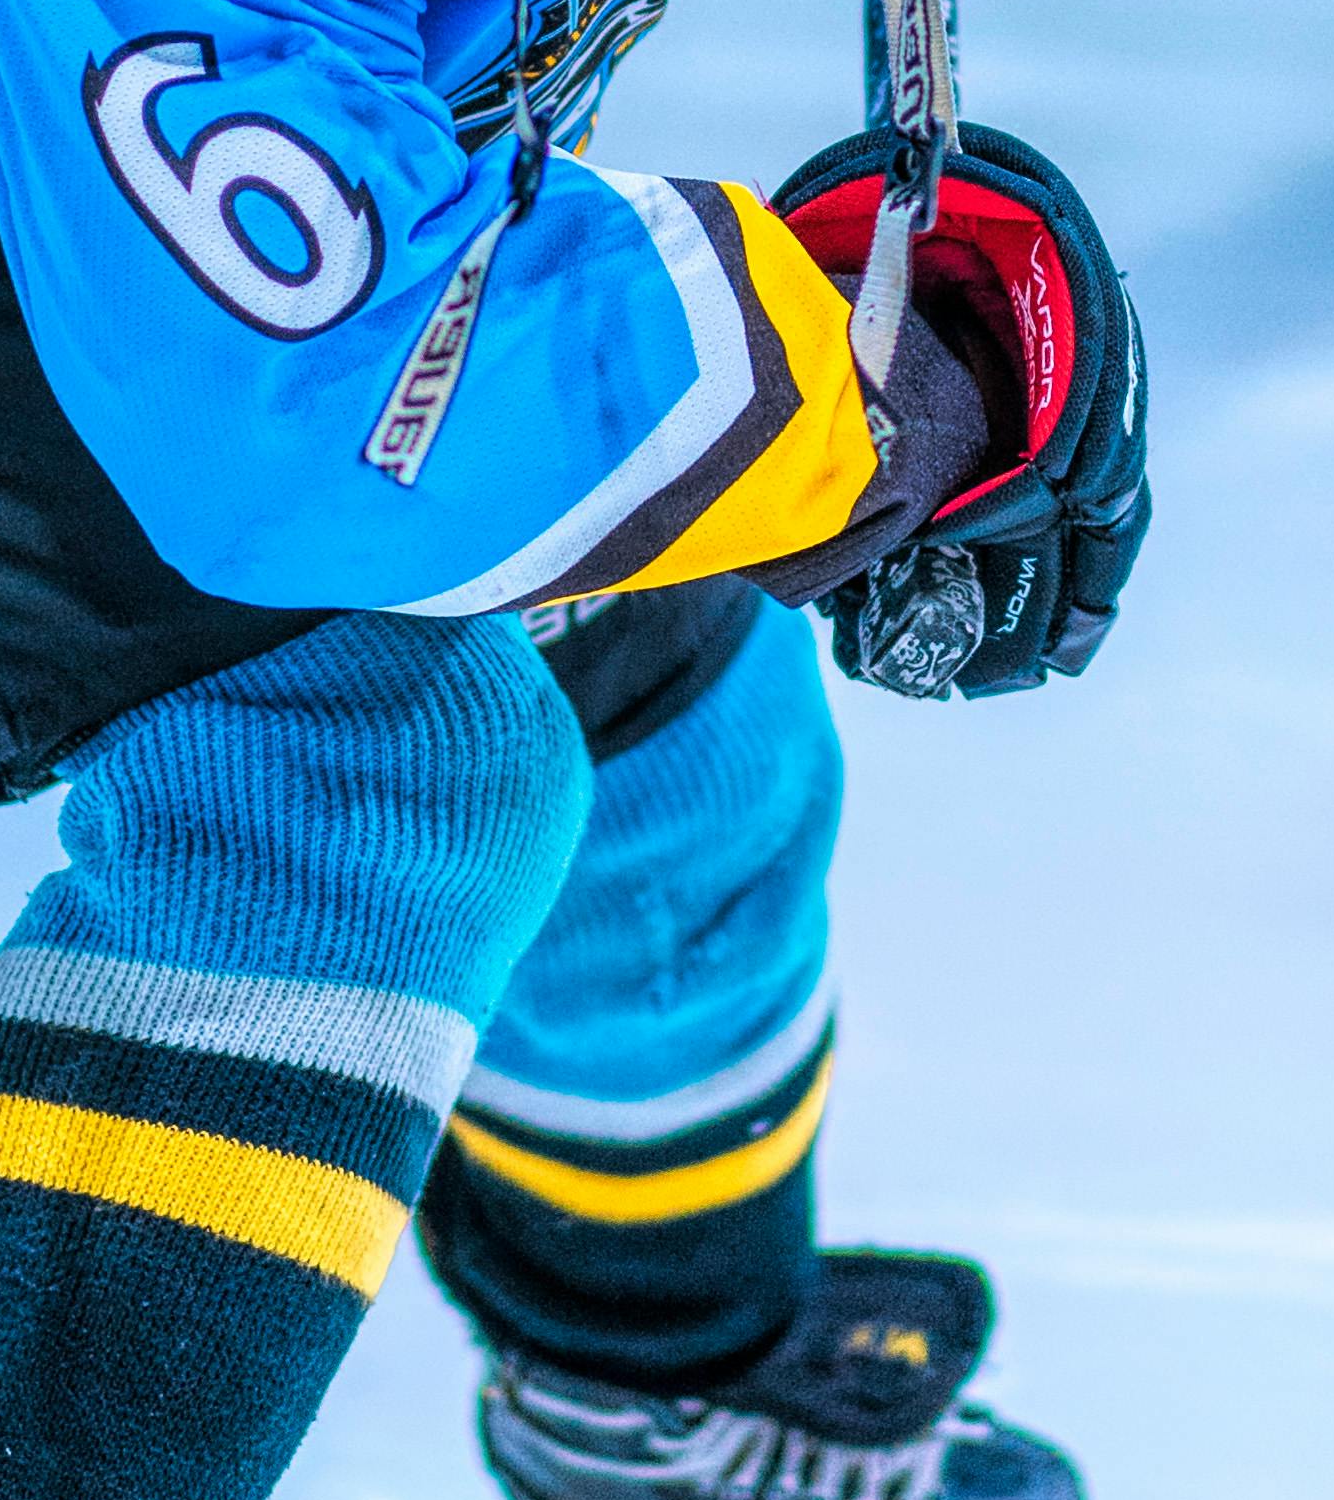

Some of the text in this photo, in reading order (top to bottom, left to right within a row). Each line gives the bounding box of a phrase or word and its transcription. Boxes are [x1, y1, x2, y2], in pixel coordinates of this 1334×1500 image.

[81, 30, 386, 342] 6
[1030, 235, 1055, 425] VAPOR
[996, 556, 1038, 633] VAPOR
